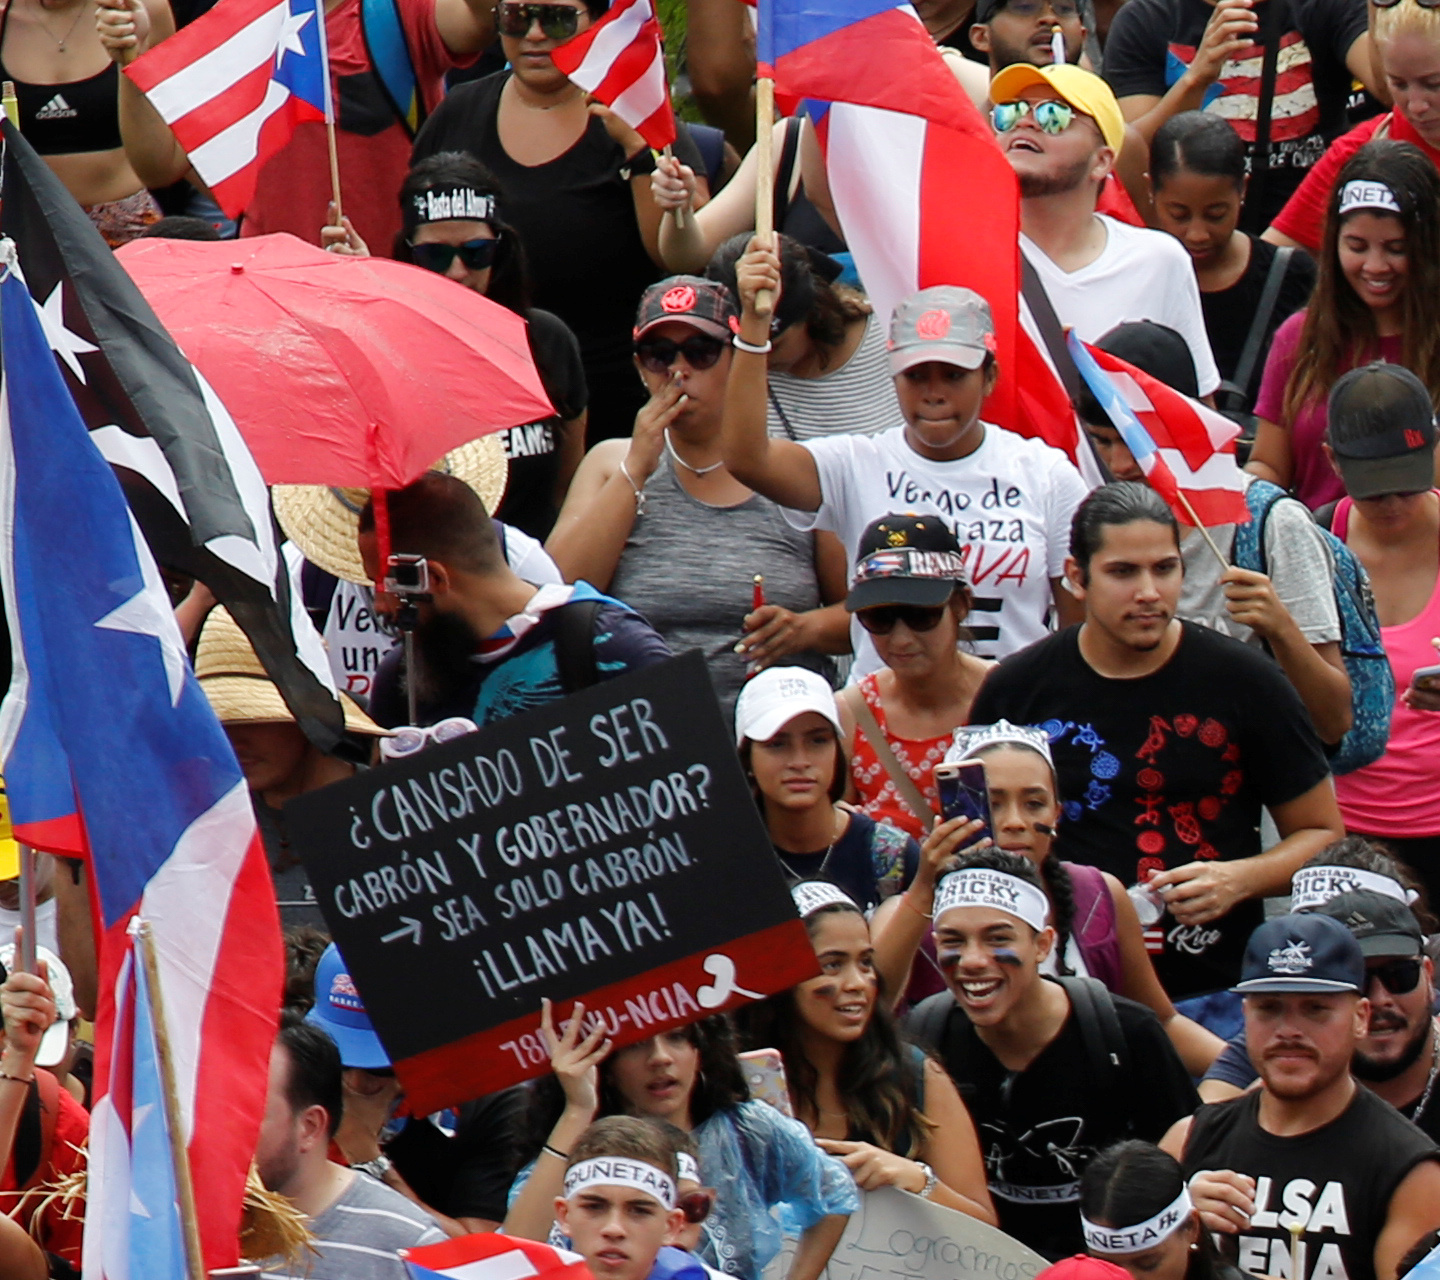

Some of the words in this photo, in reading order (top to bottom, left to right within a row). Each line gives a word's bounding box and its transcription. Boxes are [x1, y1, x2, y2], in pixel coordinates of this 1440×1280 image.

[350, 746, 524, 848] ¿CANSADO
[541, 722, 581, 789] DE
[600, 698, 673, 772] SER
[335, 846, 453, 922] CABRÓN
[462, 834, 487, 878] Y
[494, 761, 716, 868] GOBERNADOR?
[433, 896, 492, 942] SEA
[495, 866, 564, 920] SOLO
[571, 832, 702, 901] CABRÓN.
[1249, 1176, 1352, 1235] LSA
